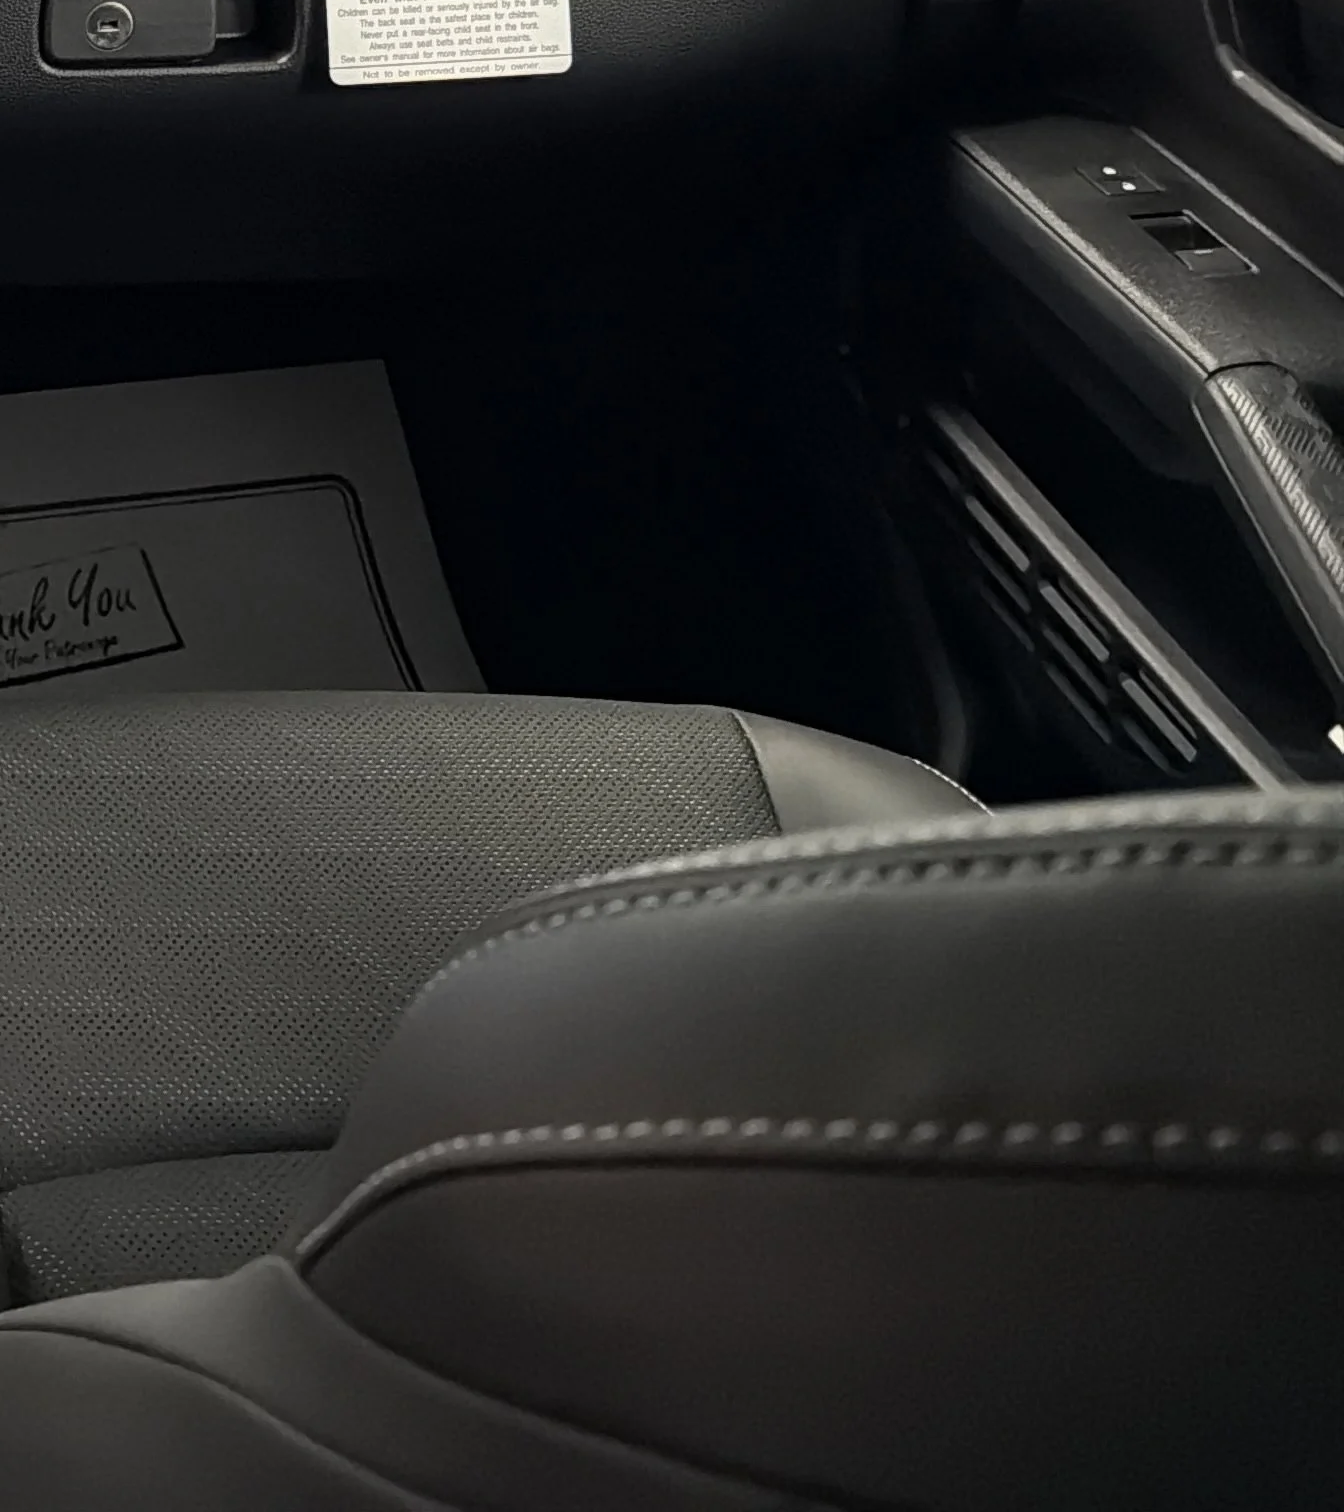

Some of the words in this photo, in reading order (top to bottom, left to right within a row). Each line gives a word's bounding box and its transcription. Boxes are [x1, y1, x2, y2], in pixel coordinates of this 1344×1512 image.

[337, 7, 368, 18] Children
[372, 8, 386, 16] can
[389, 7, 399, 15] be
[403, 5, 422, 14] killed
[437, 2, 469, 12] seriously
[473, 0, 498, 10] injured
[501, 0, 510, 9] by
[514, 0, 526, 7] the
[360, 19, 374, 28] The
[378, 17, 396, 27] back
[399, 17, 415, 26] seat
[429, 15, 441, 24] the
[445, 14, 467, 23] safest
[470, 13, 491, 23] place
[494, 12, 505, 20] for
[360, 31, 383, 40] Never
[386, 30, 399, 39] put
[411, 27, 450, 37] rear-facing
[454, 25, 471, 34] child
[475, 24, 491, 33] seat
[494, 23, 502, 31] in
[505, 23, 516, 31] the
[369, 42, 395, 51] Always
[399, 41, 413, 49] use
[416, 40, 432, 48] seat
[436, 38, 454, 47] belts
[458, 37, 472, 45] and
[475, 35, 493, 44] child
[340, 55, 356, 64] See
[392, 51, 419, 60] manual
[423, 50, 433, 59] for
[437, 49, 456, 58] more
[460, 47, 500, 57] information
[504, 46, 524, 55] about
[362, 70, 379, 79] Not
[384, 69, 393, 78] to
[398, 68, 410, 77] be
[415, 66, 455, 76] removed
[459, 64, 490, 74] except
[494, 63, 505, 72] by
[68, 563, 137, 626] You
